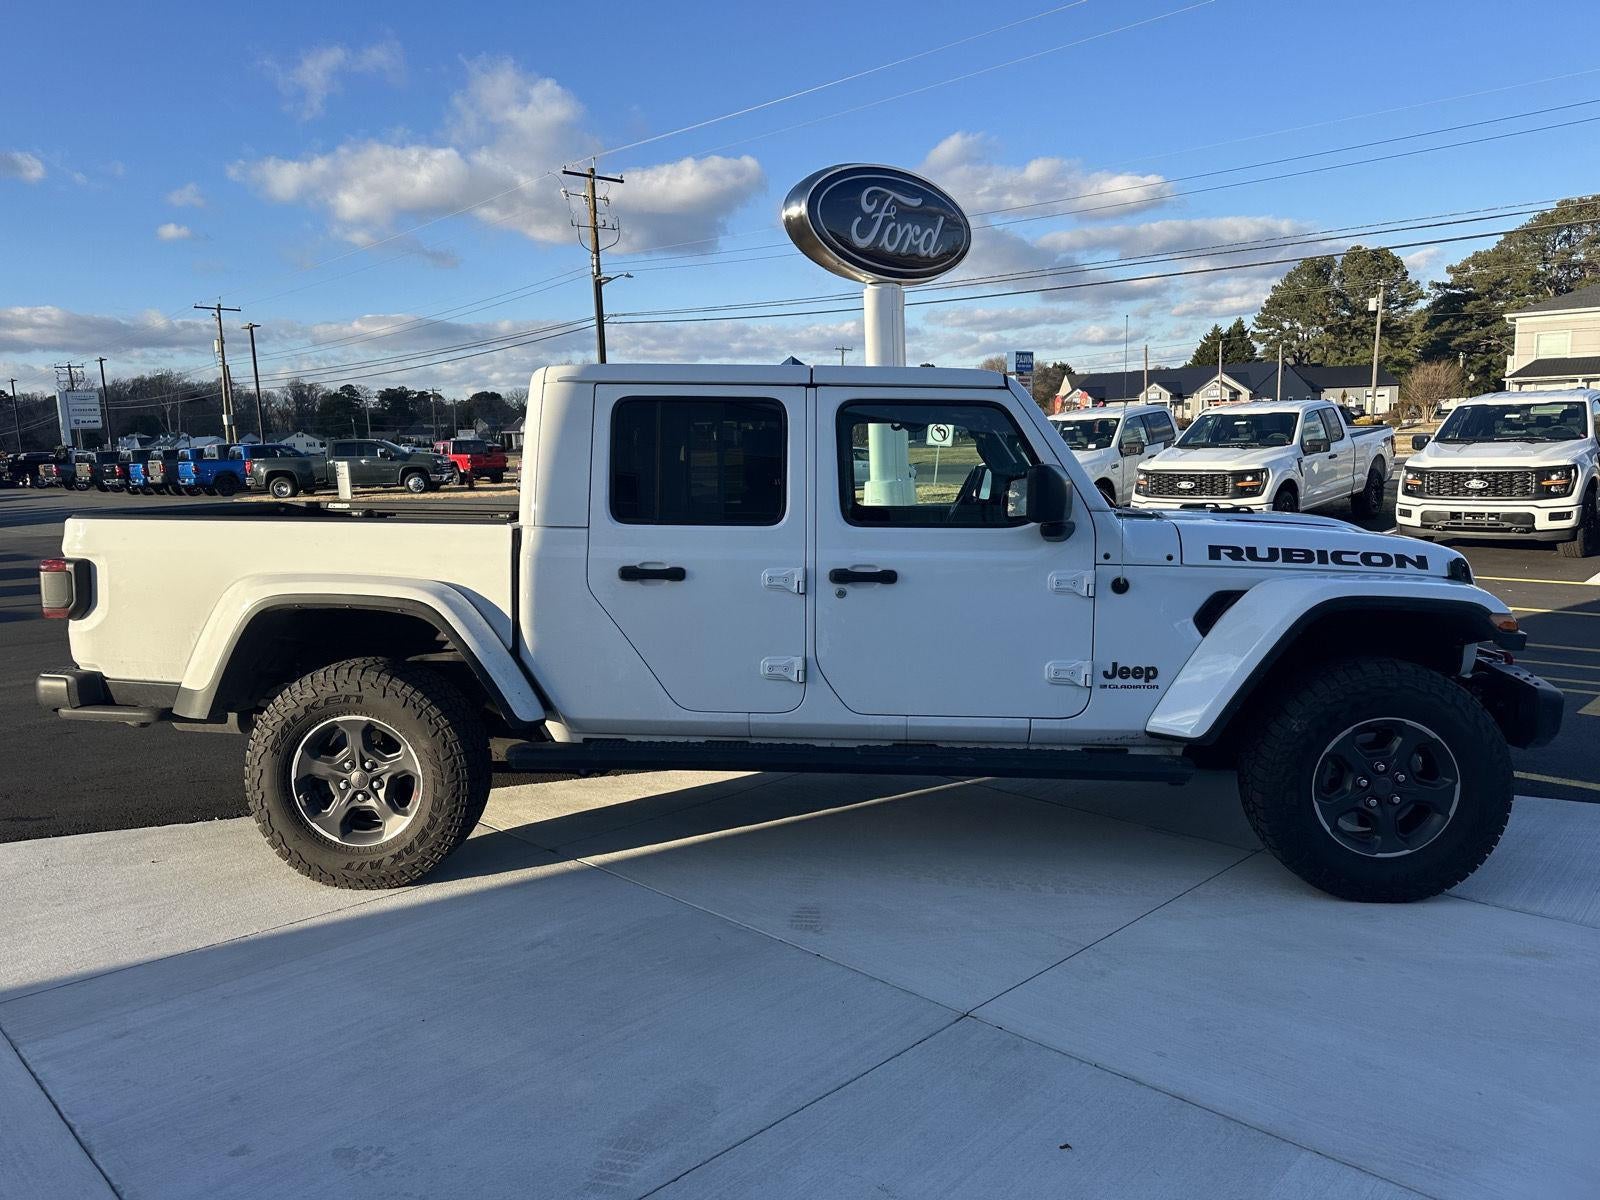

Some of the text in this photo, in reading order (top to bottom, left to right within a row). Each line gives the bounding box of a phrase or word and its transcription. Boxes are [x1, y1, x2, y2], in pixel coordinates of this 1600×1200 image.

[851, 186, 944, 258] Ford
[1016, 354, 1032, 364] PAWN
[1207, 544, 1428, 570] RUBICON
[1102, 661, 1159, 683] Jeep
